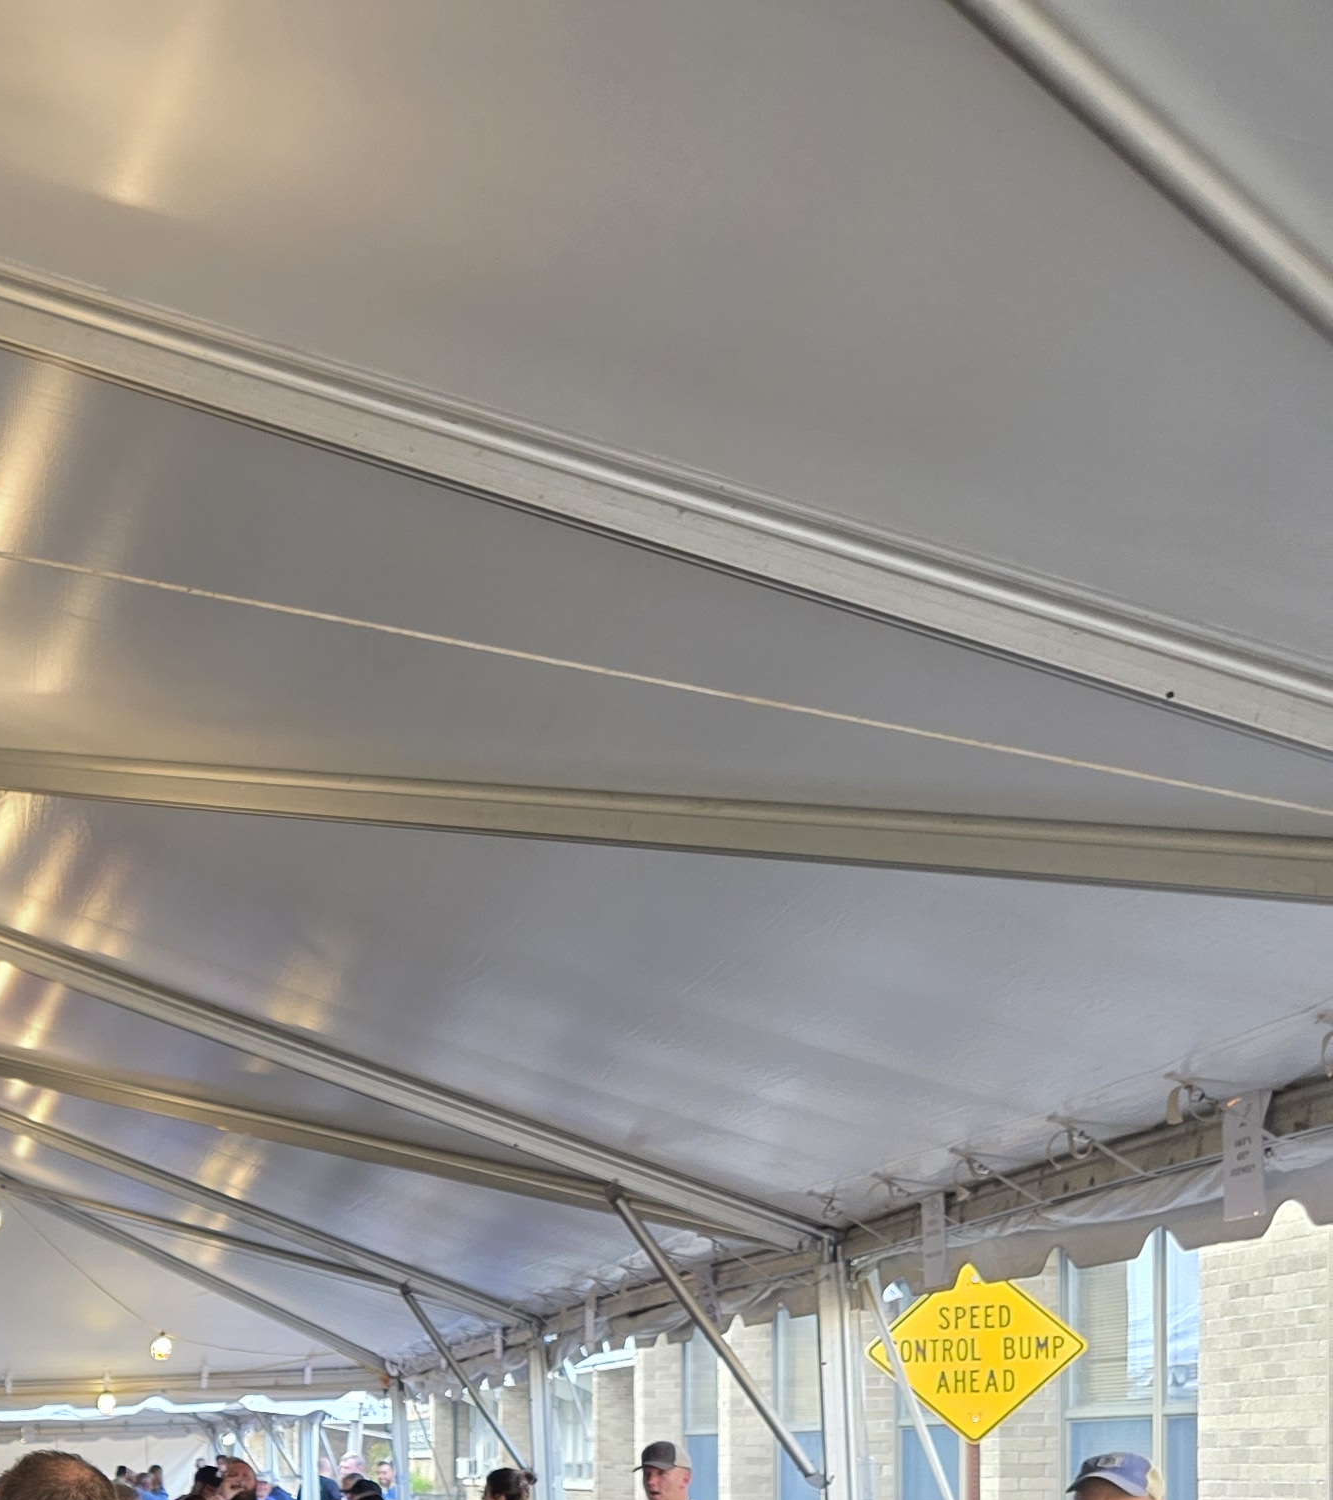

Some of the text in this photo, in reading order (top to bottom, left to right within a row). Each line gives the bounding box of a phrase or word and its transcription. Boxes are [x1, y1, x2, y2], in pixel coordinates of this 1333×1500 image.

[938, 1304, 1011, 1330] SPEED
[887, 1336, 1065, 1363] ONTROL BUMP
[936, 1369, 1016, 1394] AHEAD
